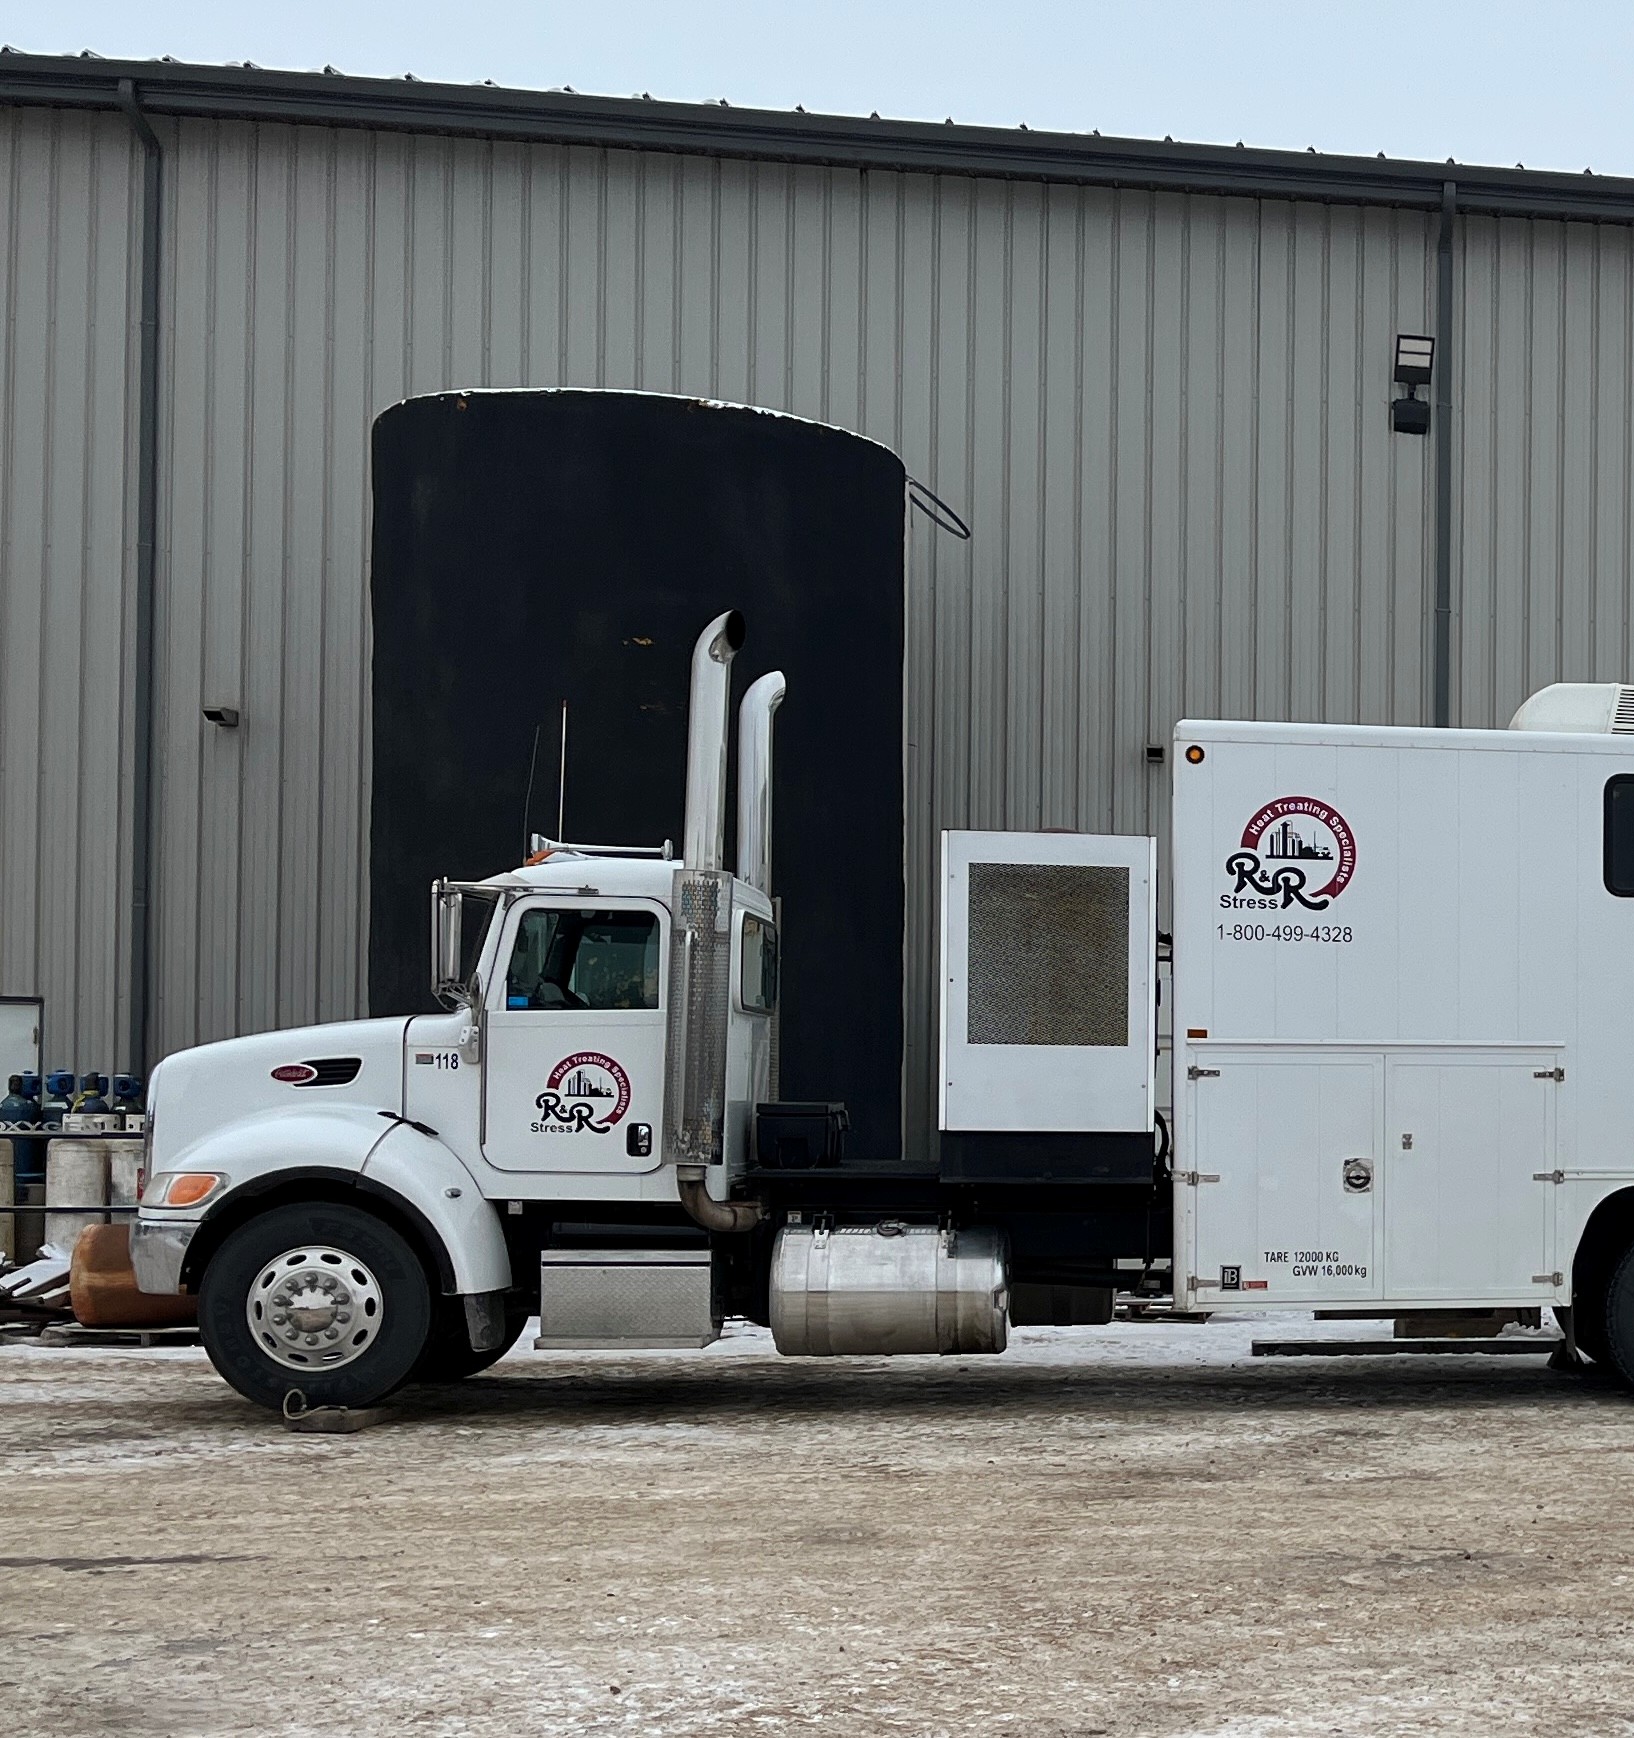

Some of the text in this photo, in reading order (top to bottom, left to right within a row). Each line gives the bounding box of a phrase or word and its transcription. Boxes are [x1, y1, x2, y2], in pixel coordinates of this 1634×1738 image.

[1249, 801, 1353, 883] Heat Treating Specialists
[1225, 852, 1329, 911] R&R
[1220, 894, 1278, 909] Stress
[1217, 923, 1353, 942] 1-800-499-4328
[436, 1052, 459, 1070] 118
[553, 1055, 628, 1114] Heat Treating Specialists
[535, 1092, 611, 1134] R&R
[530, 1122, 573, 1133] Stress
[1264, 1251, 1339, 1263] TARE 12000 KG
[1292, 1265, 1318, 1276] GVW
